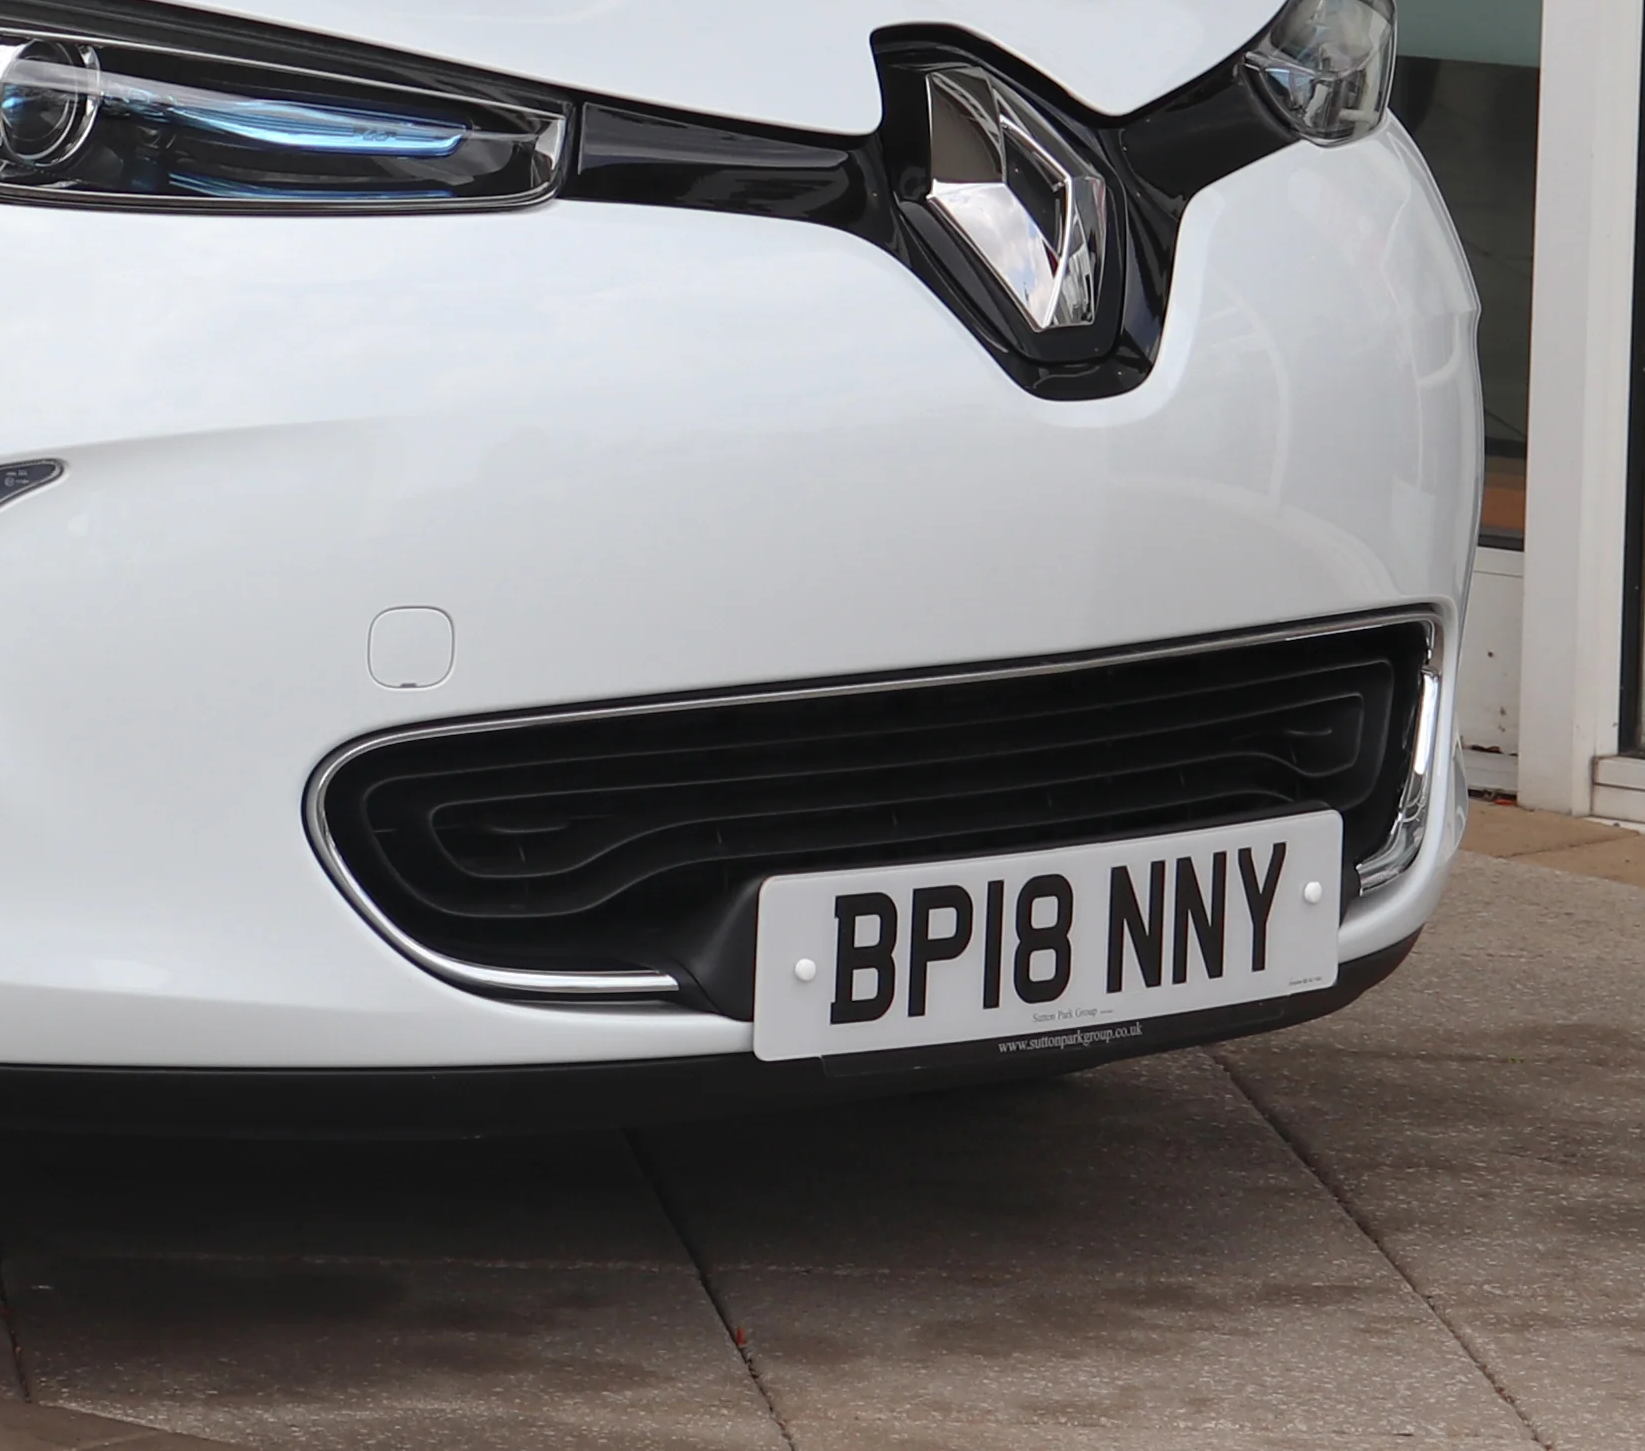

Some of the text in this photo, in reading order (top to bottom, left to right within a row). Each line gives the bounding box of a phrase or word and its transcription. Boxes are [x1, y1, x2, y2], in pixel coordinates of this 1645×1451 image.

[829, 841, 1288, 1026] BP18 NNY
[998, 1021, 1143, 1053] www.suttonparkgroup.co.uk
